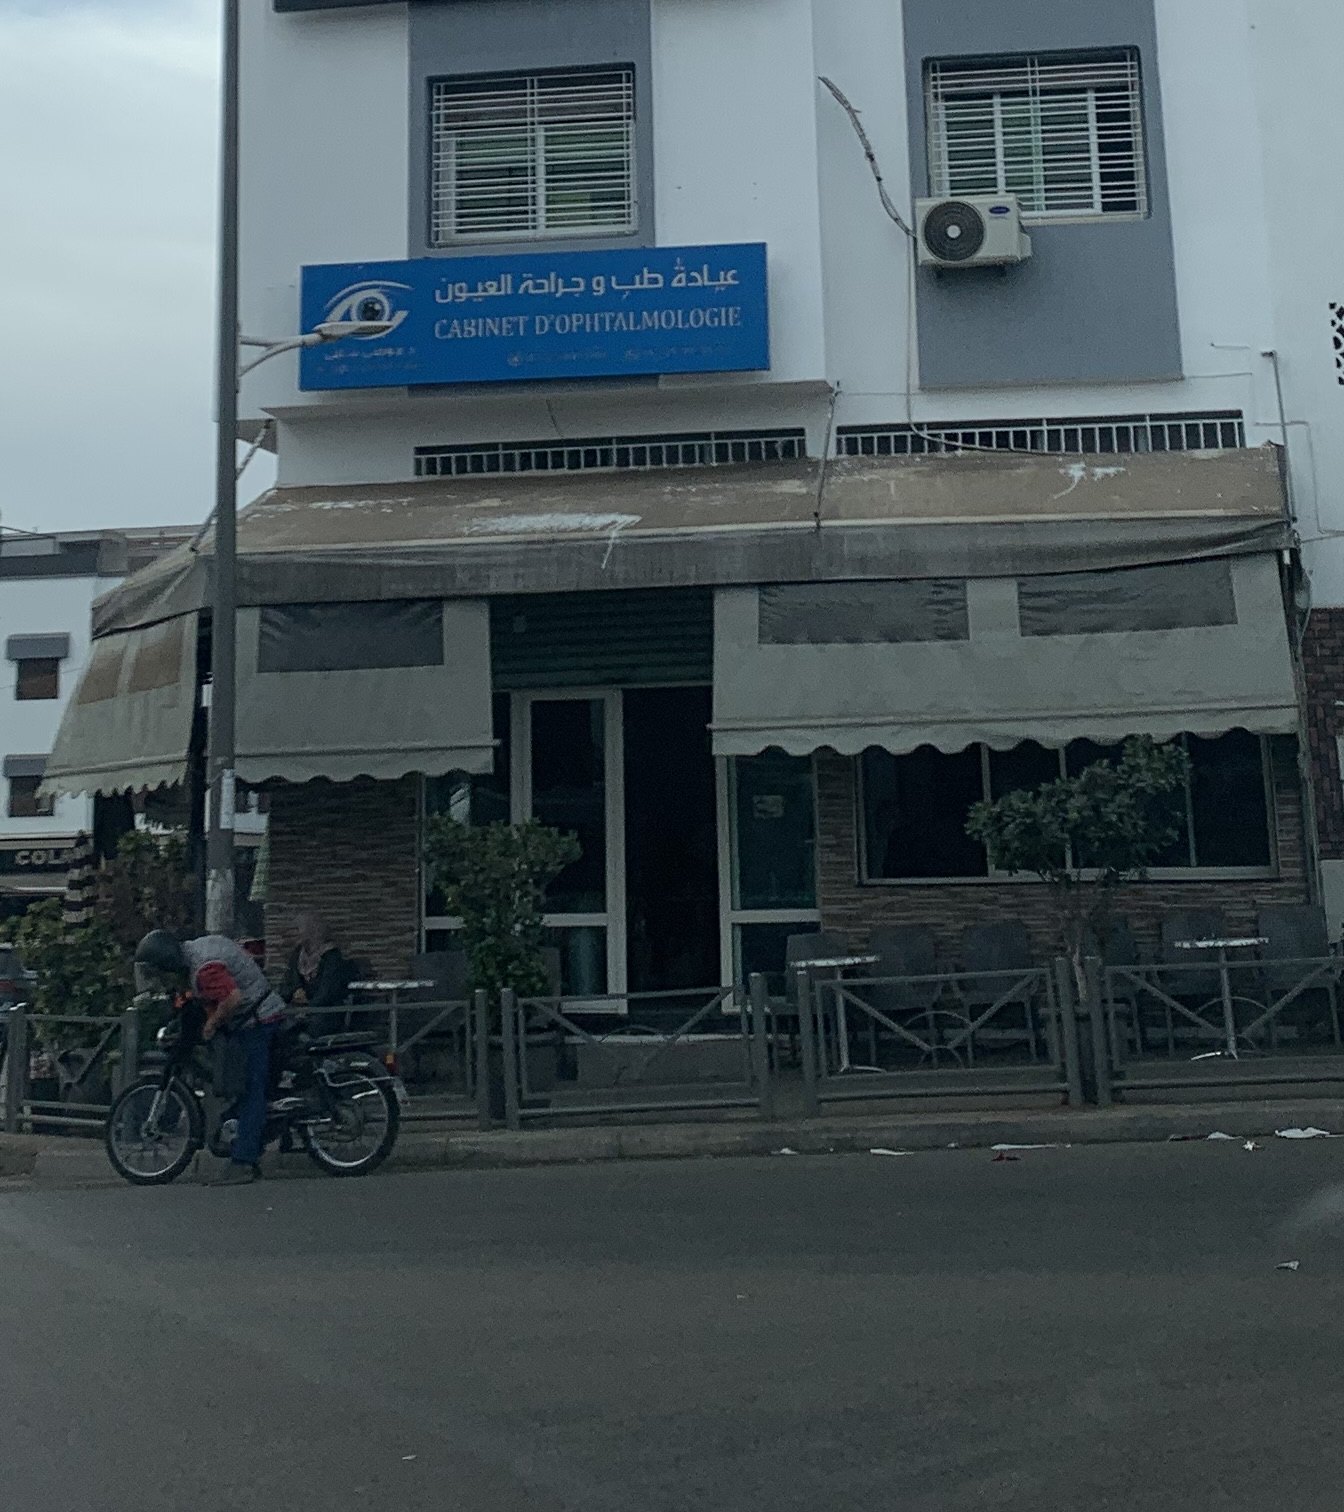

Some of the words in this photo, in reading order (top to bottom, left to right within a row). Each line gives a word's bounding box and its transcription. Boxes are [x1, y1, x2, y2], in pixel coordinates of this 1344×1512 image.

[434, 274, 512, 304] العيون
[518, 271, 585, 298] جراحة
[591, 275, 605, 296] و
[611, 266, 664, 299] طب
[671, 259, 740, 291] عيادة
[434, 315, 529, 338] CABINET
[535, 306, 741, 336] D'OPHTALMOLOGIE
